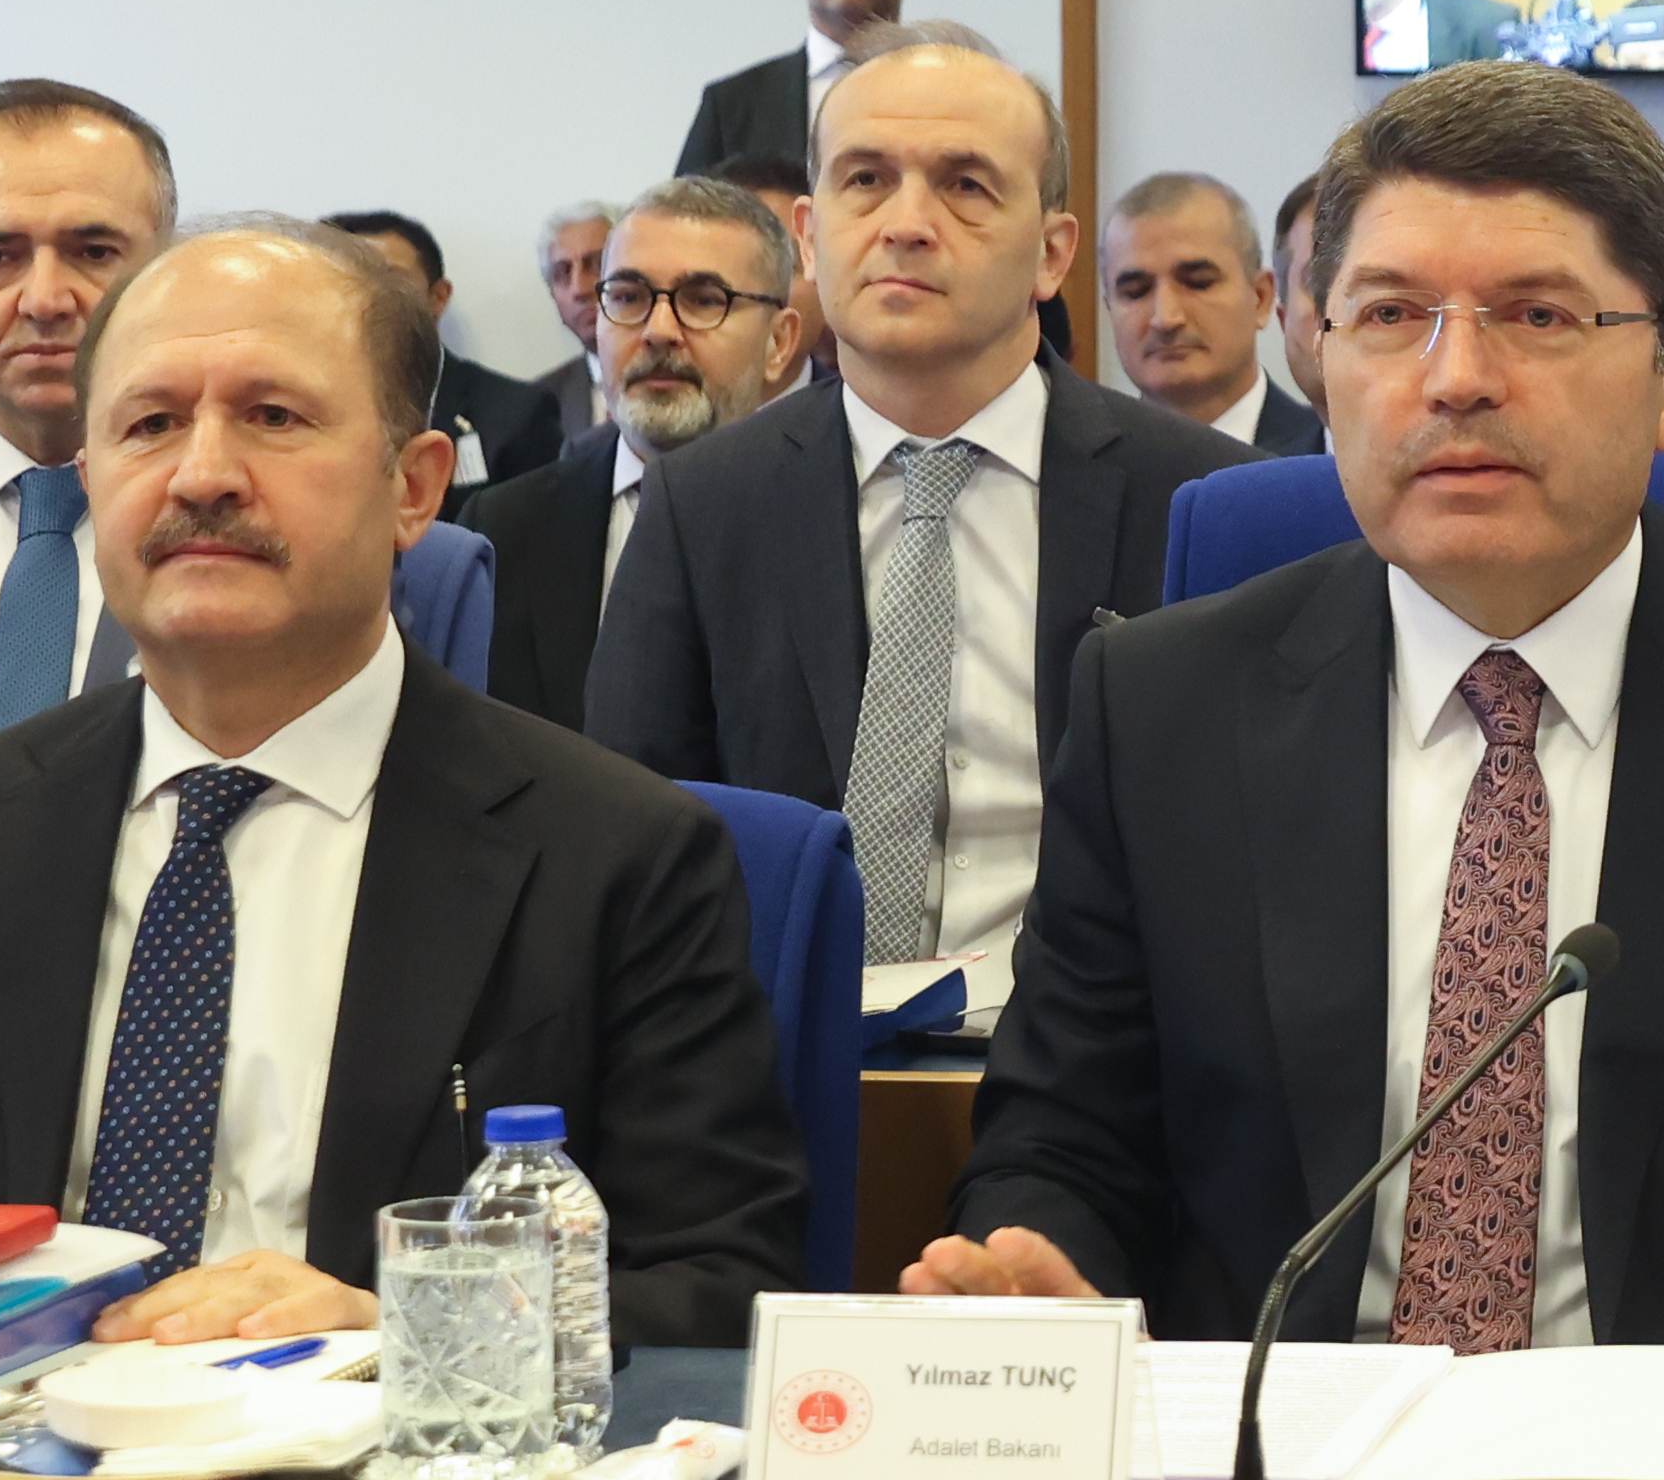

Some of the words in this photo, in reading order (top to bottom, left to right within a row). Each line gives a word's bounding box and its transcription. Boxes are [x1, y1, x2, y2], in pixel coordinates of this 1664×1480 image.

[907, 1364, 992, 1386] Yılmaz
[1002, 1366, 1077, 1393] TUNÇ
[909, 1438, 979, 1458] Adalet
[986, 1438, 1062, 1459] Bakanı
